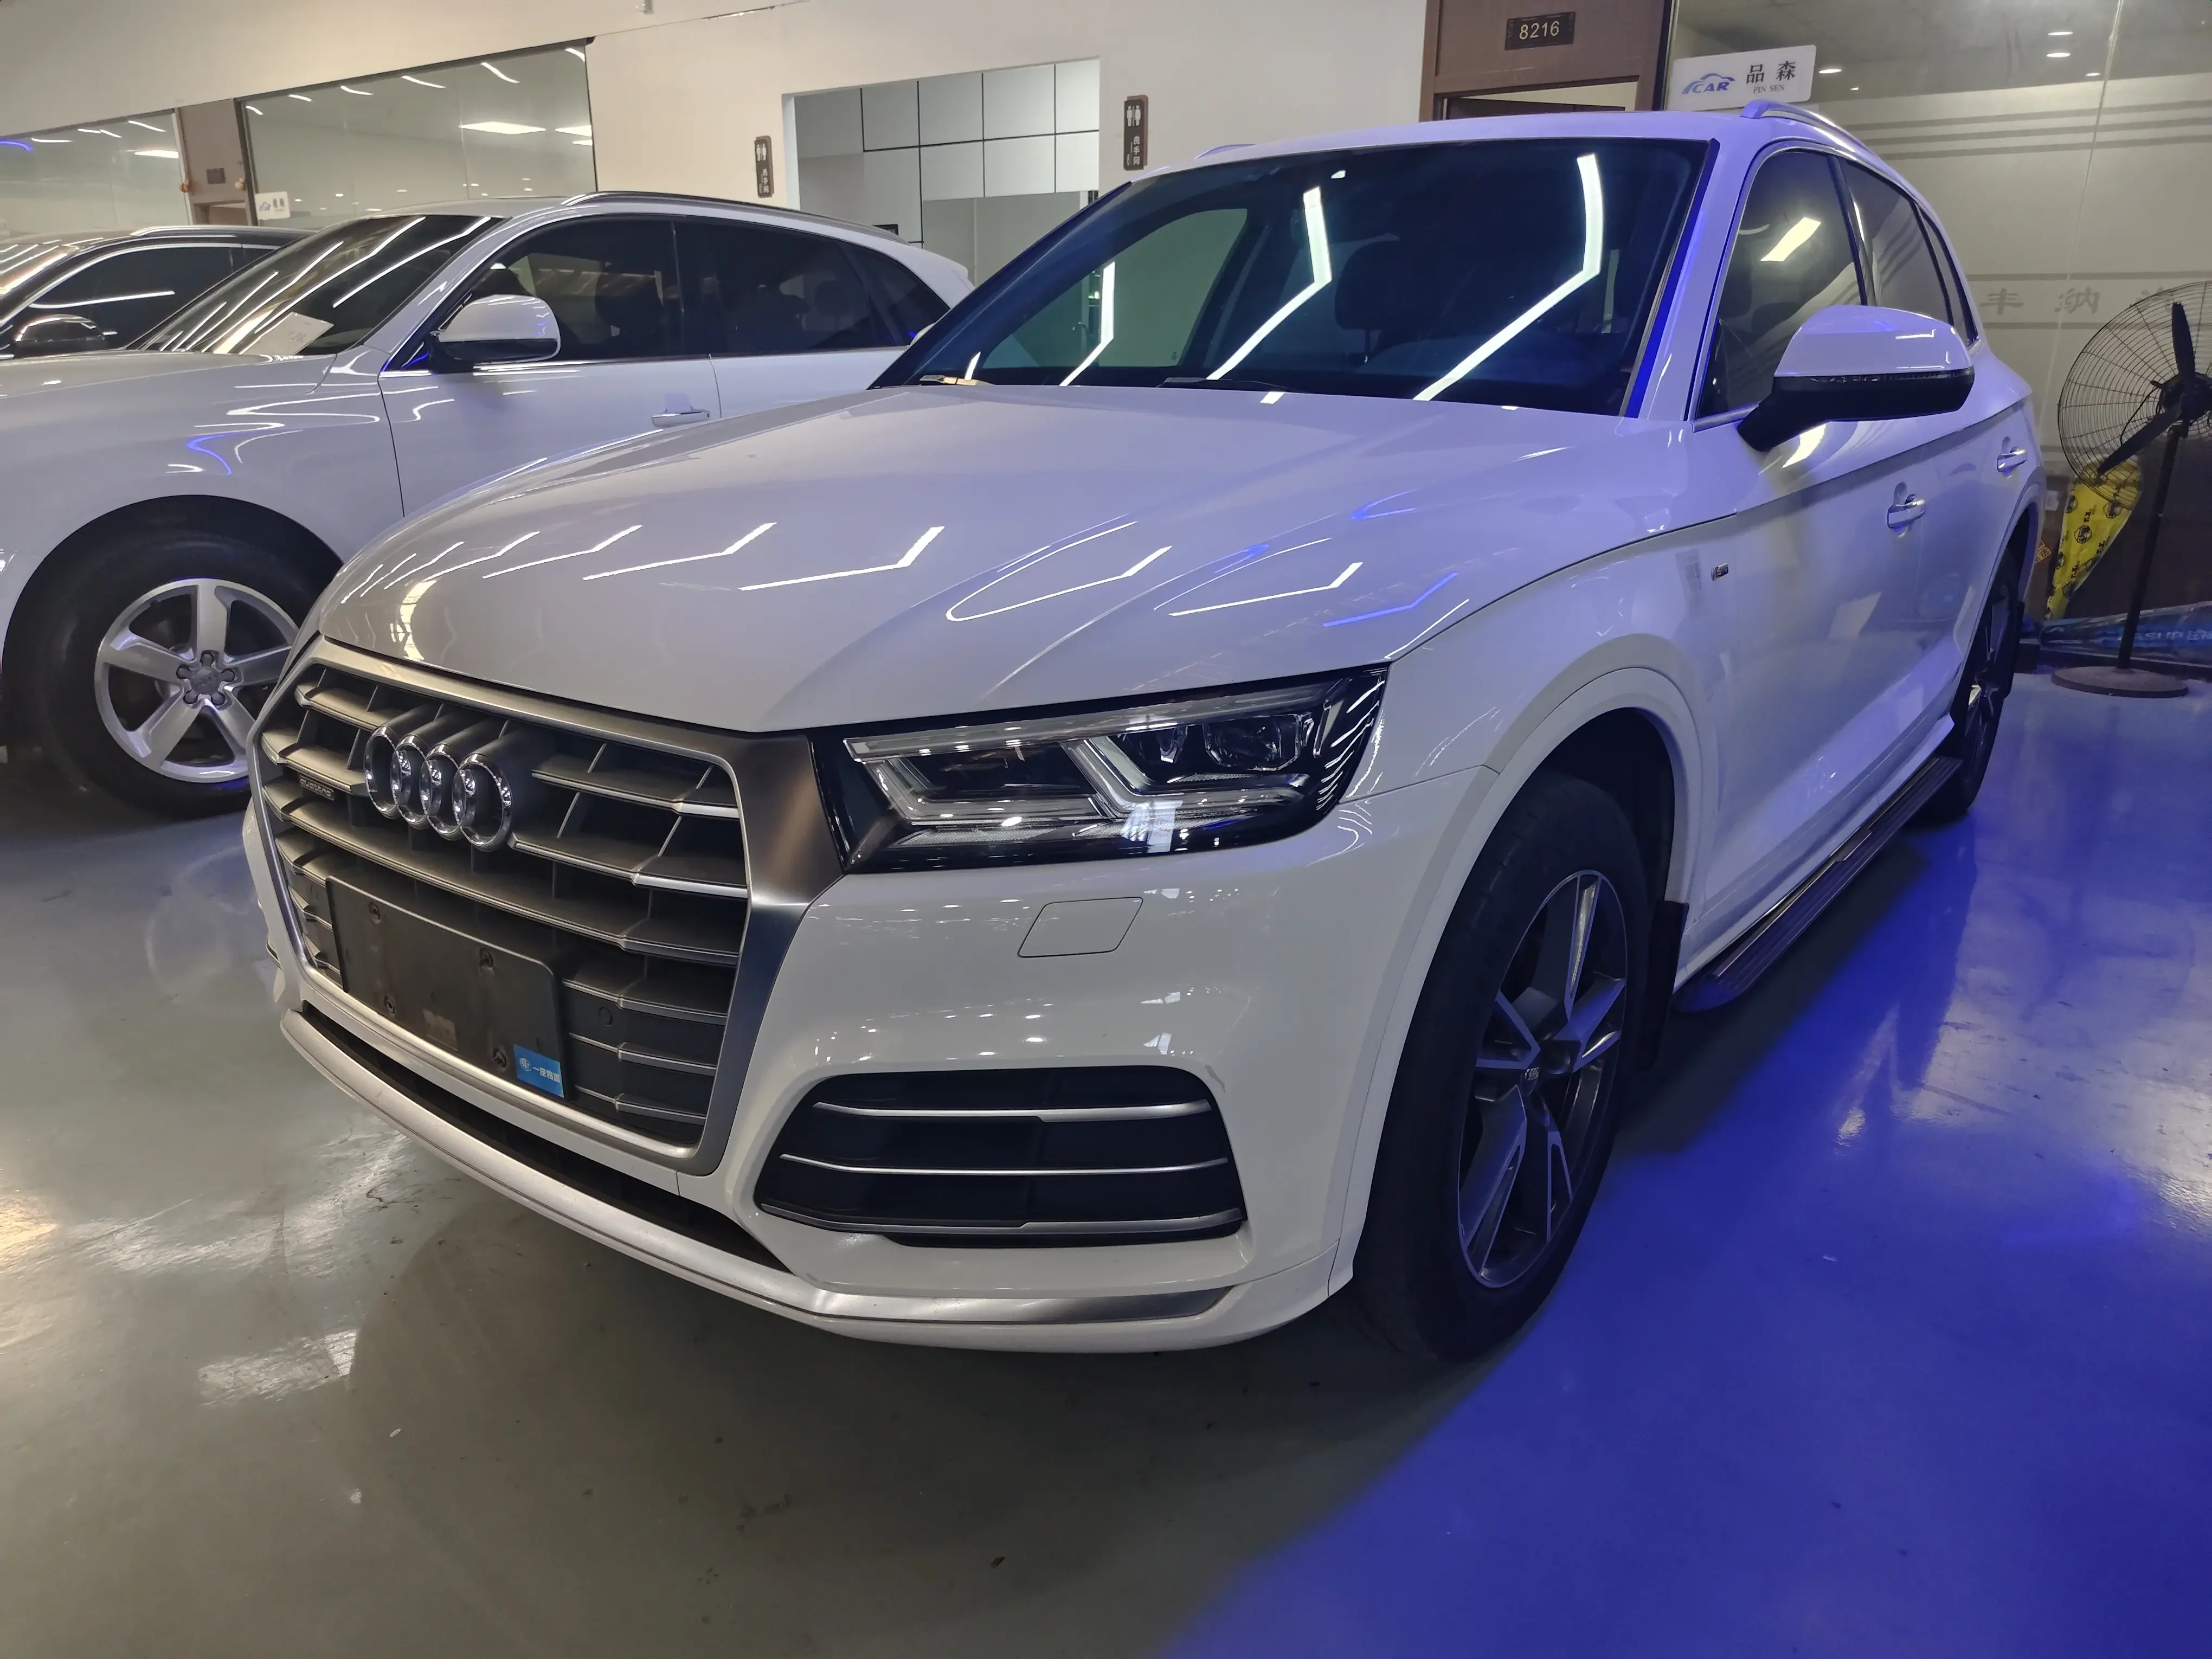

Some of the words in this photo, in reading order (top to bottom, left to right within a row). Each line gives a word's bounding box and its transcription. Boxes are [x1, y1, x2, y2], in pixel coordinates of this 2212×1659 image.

[1519, 21, 1560, 40] 8216
[1746, 60, 1796, 84] 品森
[1692, 81, 1729, 94] CAR
[1753, 86, 1767, 94] PIN
[1770, 83, 1785, 93] SEN
[300, 778, 331, 798] quattro
